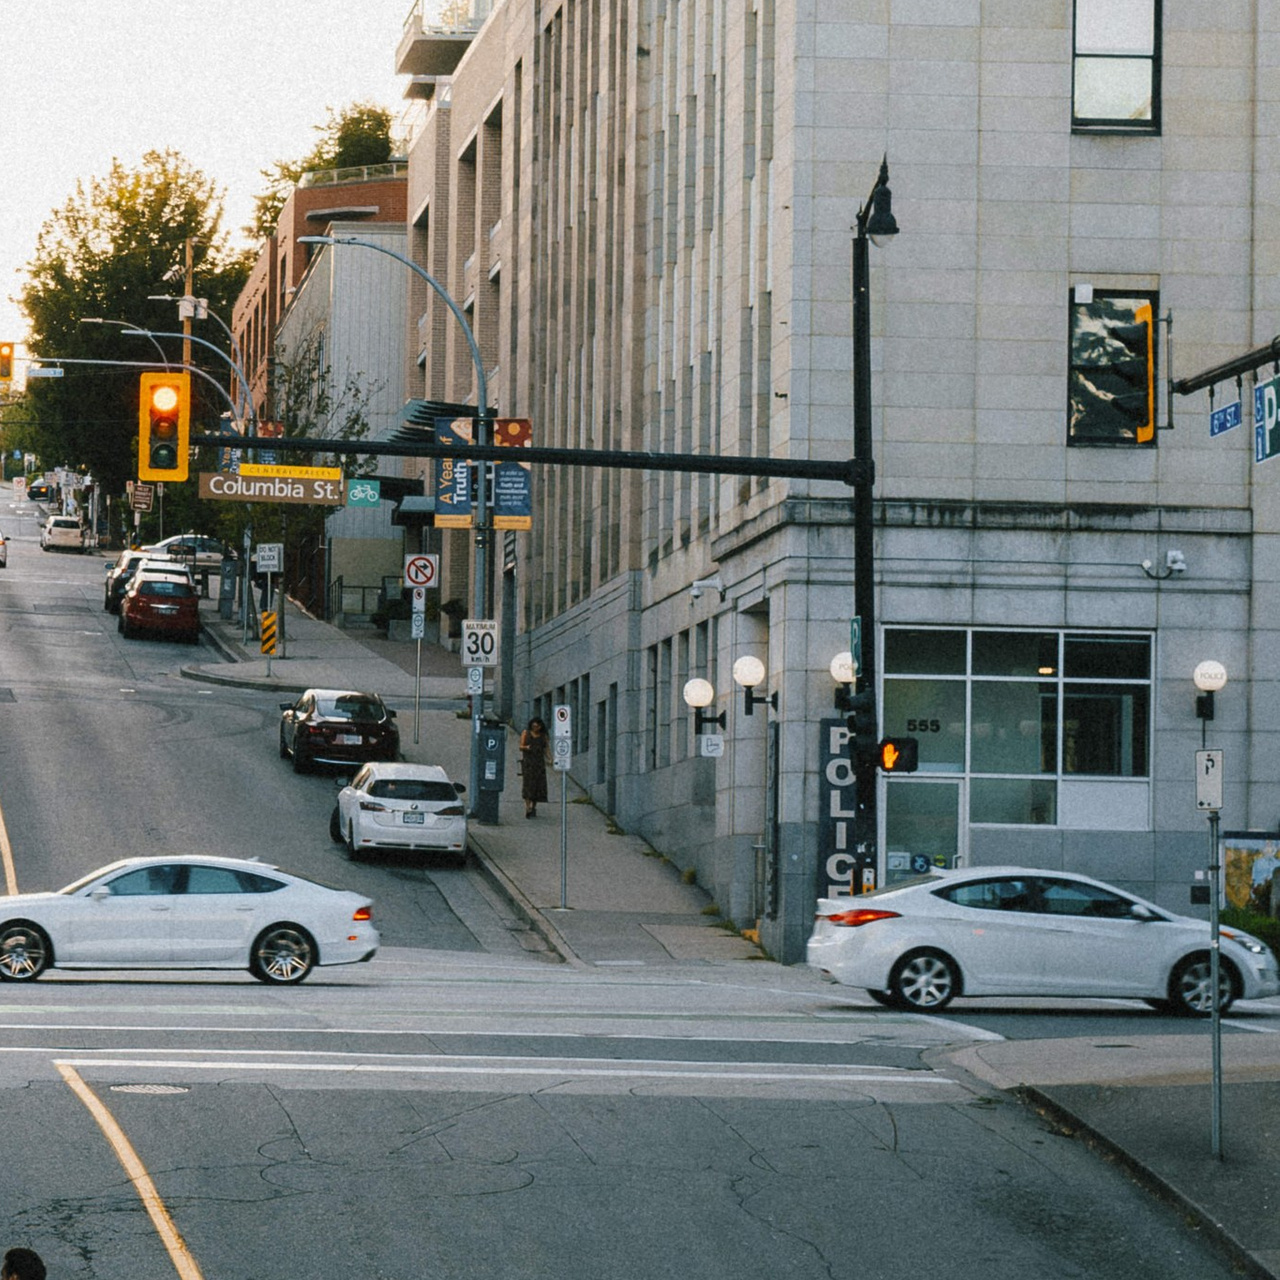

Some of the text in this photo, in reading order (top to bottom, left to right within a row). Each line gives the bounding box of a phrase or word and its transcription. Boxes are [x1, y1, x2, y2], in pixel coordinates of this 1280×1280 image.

[249, 466, 332, 477] CENTRAL VALLEY
[209, 476, 339, 500] Columbia St.
[453, 462, 467, 505] Truth
[467, 631, 495, 655] 30
[906, 719, 941, 733] 555
[487, 738, 496, 748] P
